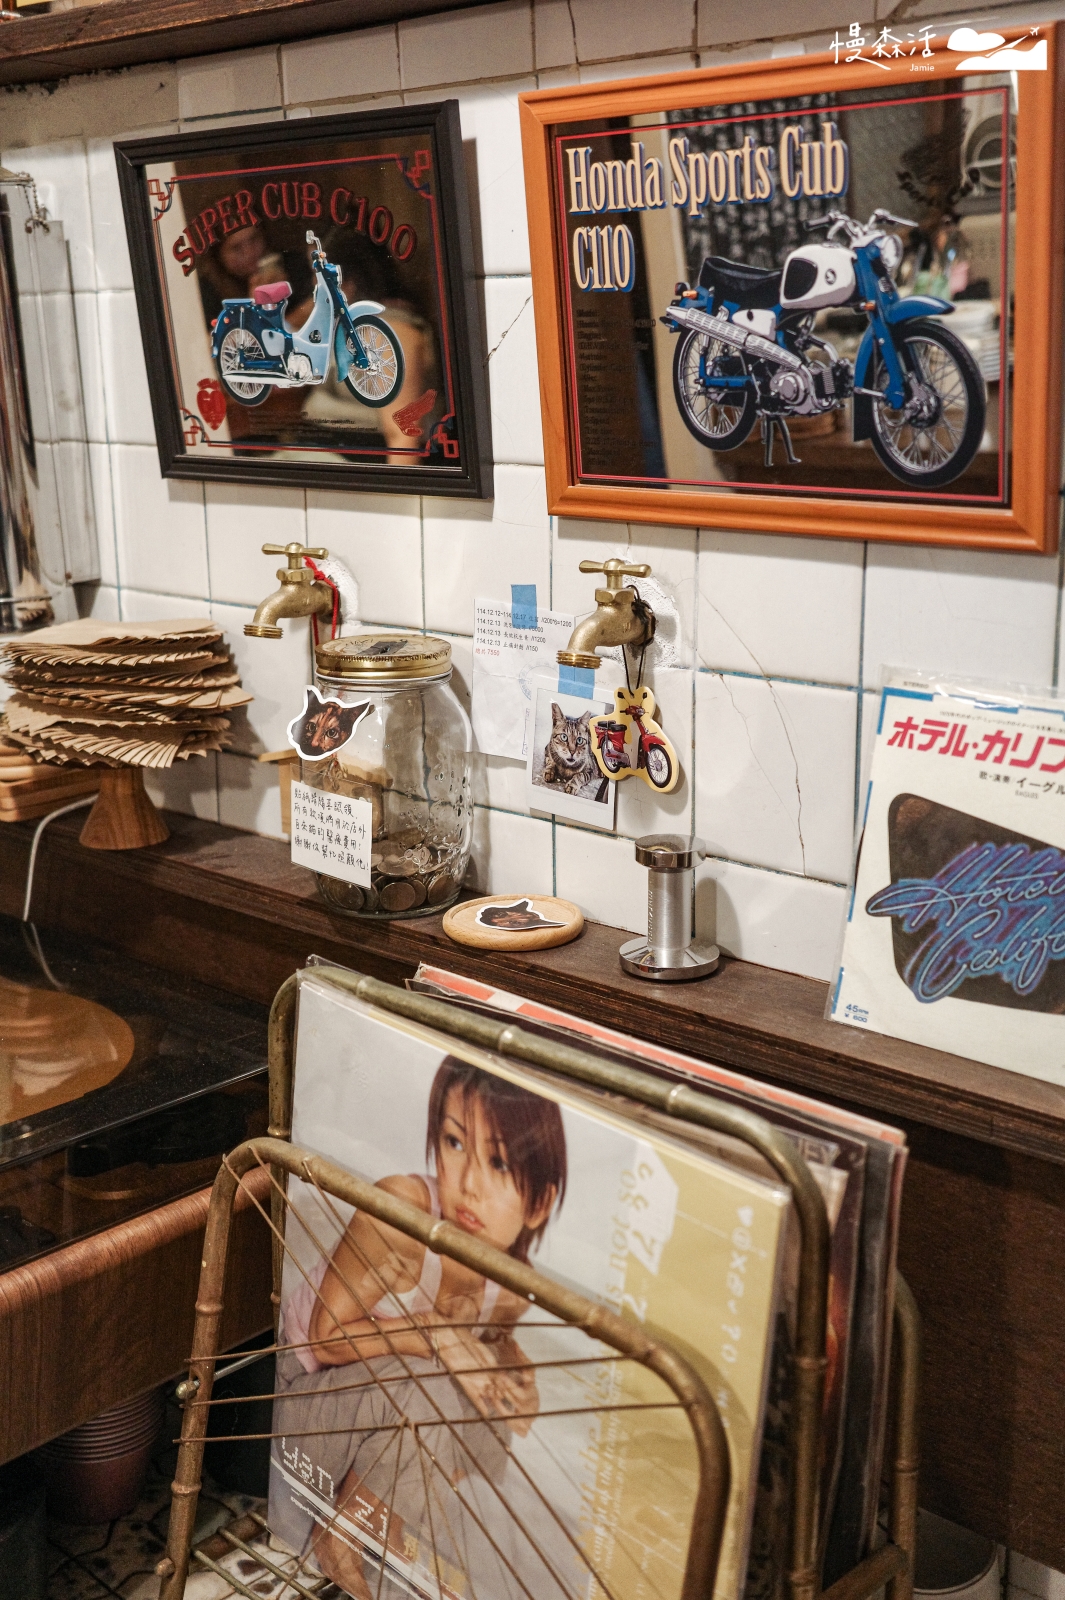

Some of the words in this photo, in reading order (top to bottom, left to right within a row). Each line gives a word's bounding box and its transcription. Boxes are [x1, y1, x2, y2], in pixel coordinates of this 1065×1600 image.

[566, 141, 667, 215] Honda
[669, 136, 775, 218] Sports
[779, 121, 849, 202] Cub
[172, 189, 260, 277] SUPER
[261, 181, 323, 220] CUB
[329, 187, 418, 263] C100
[572, 224, 635, 292] C110
